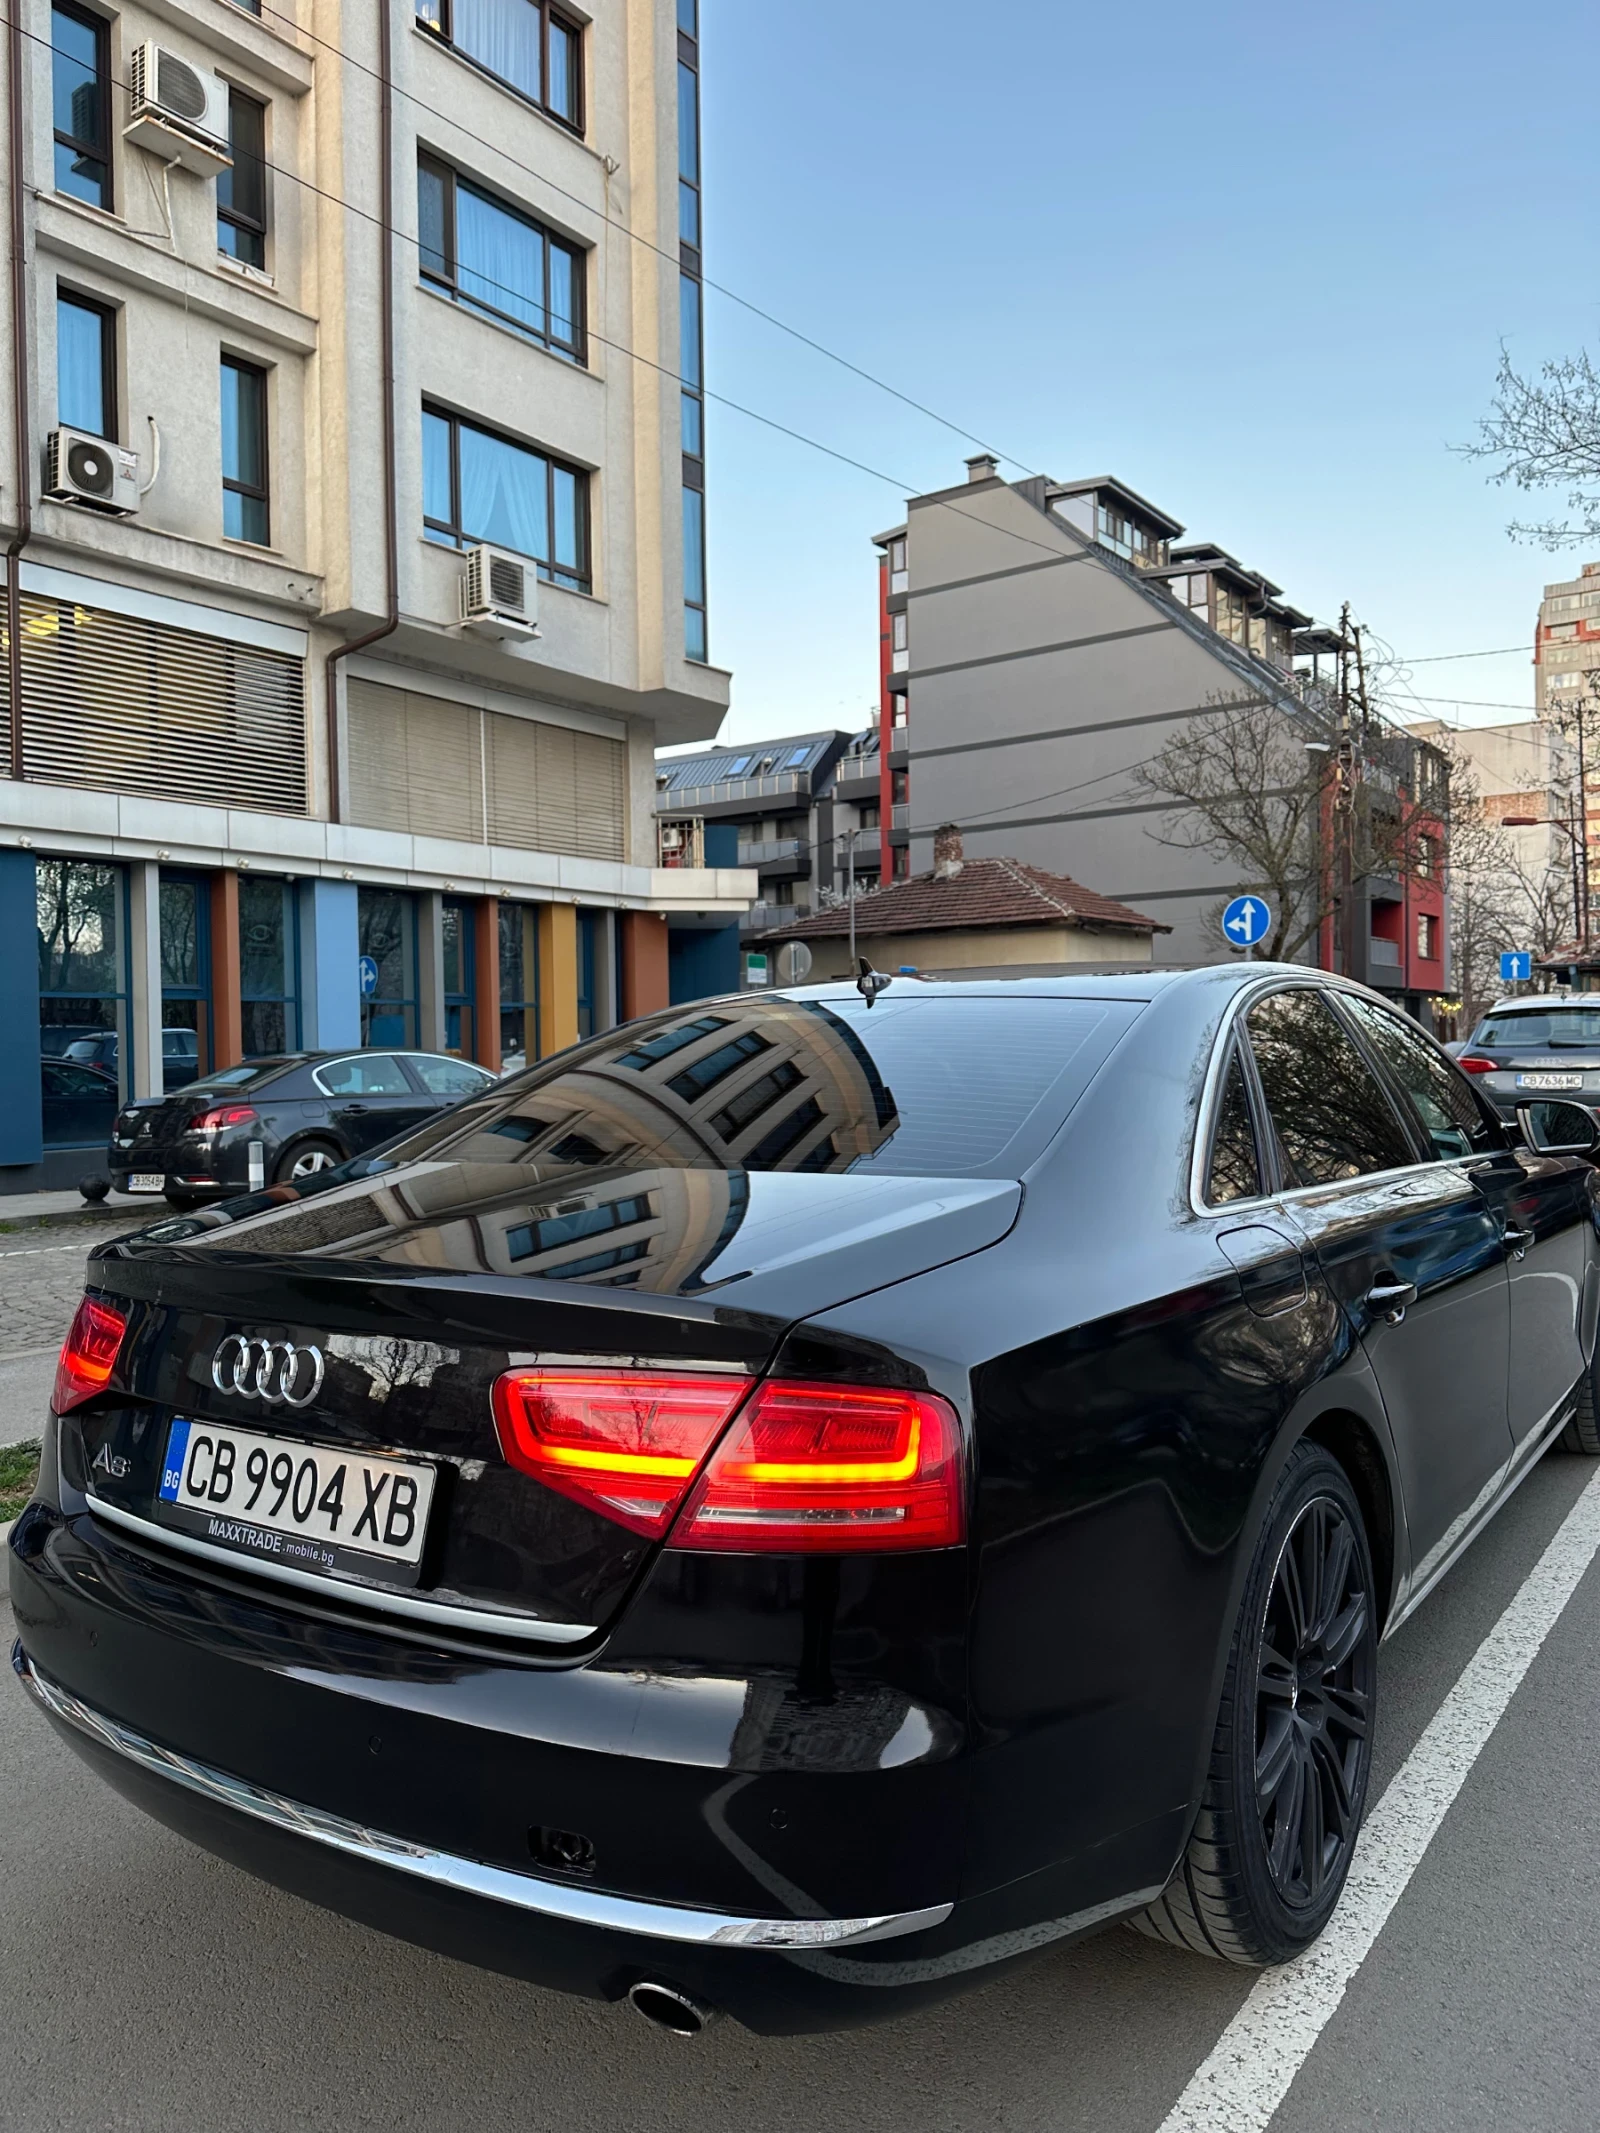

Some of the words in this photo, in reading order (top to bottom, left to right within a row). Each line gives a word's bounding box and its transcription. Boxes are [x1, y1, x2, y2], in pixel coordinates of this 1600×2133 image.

[1523, 1075, 1537, 1085] CB
[1538, 1075, 1565, 1086] 7636
[163, 1469, 179, 1489] BG
[186, 1435, 236, 1503] CB
[244, 1448, 347, 1532] 9904
[352, 1468, 418, 1547] XB
